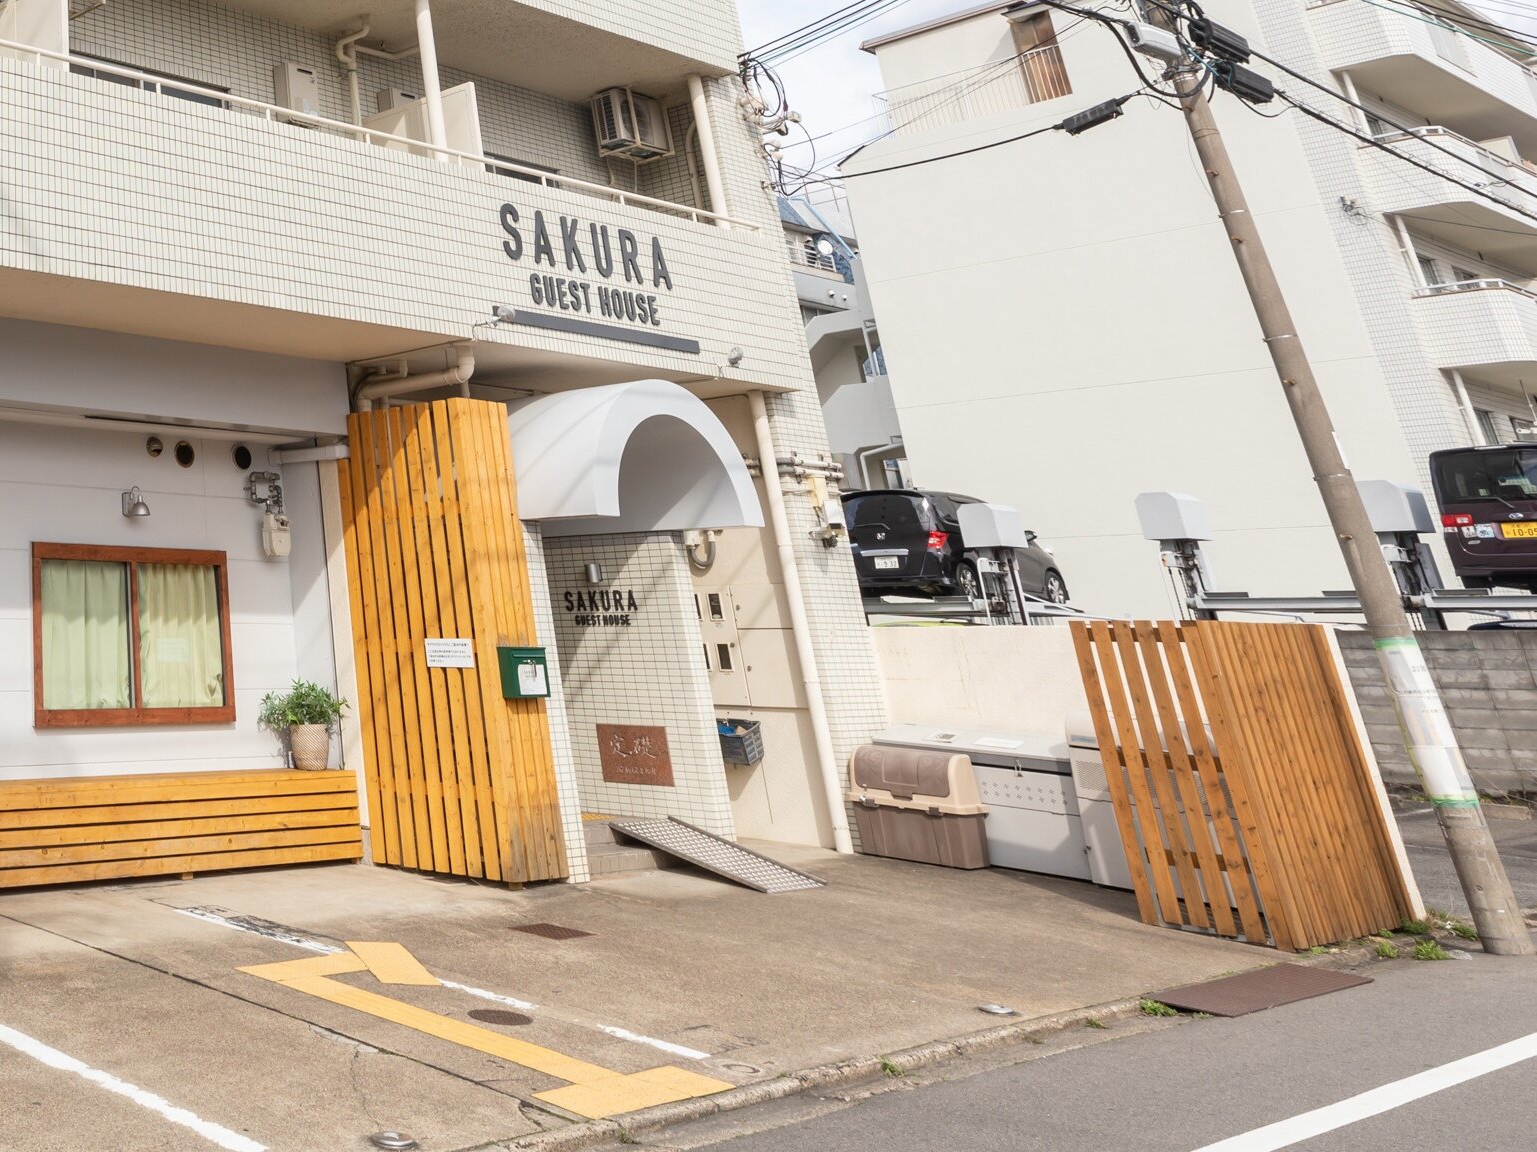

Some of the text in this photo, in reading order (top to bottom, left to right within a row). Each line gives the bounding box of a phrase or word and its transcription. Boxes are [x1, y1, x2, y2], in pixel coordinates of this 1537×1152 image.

[499, 203, 673, 290] SAKURA
[530, 273, 660, 325] GUEST HOUSE
[564, 589, 638, 612] SAKURA
[575, 614, 631, 626] GUEST HOUSE
